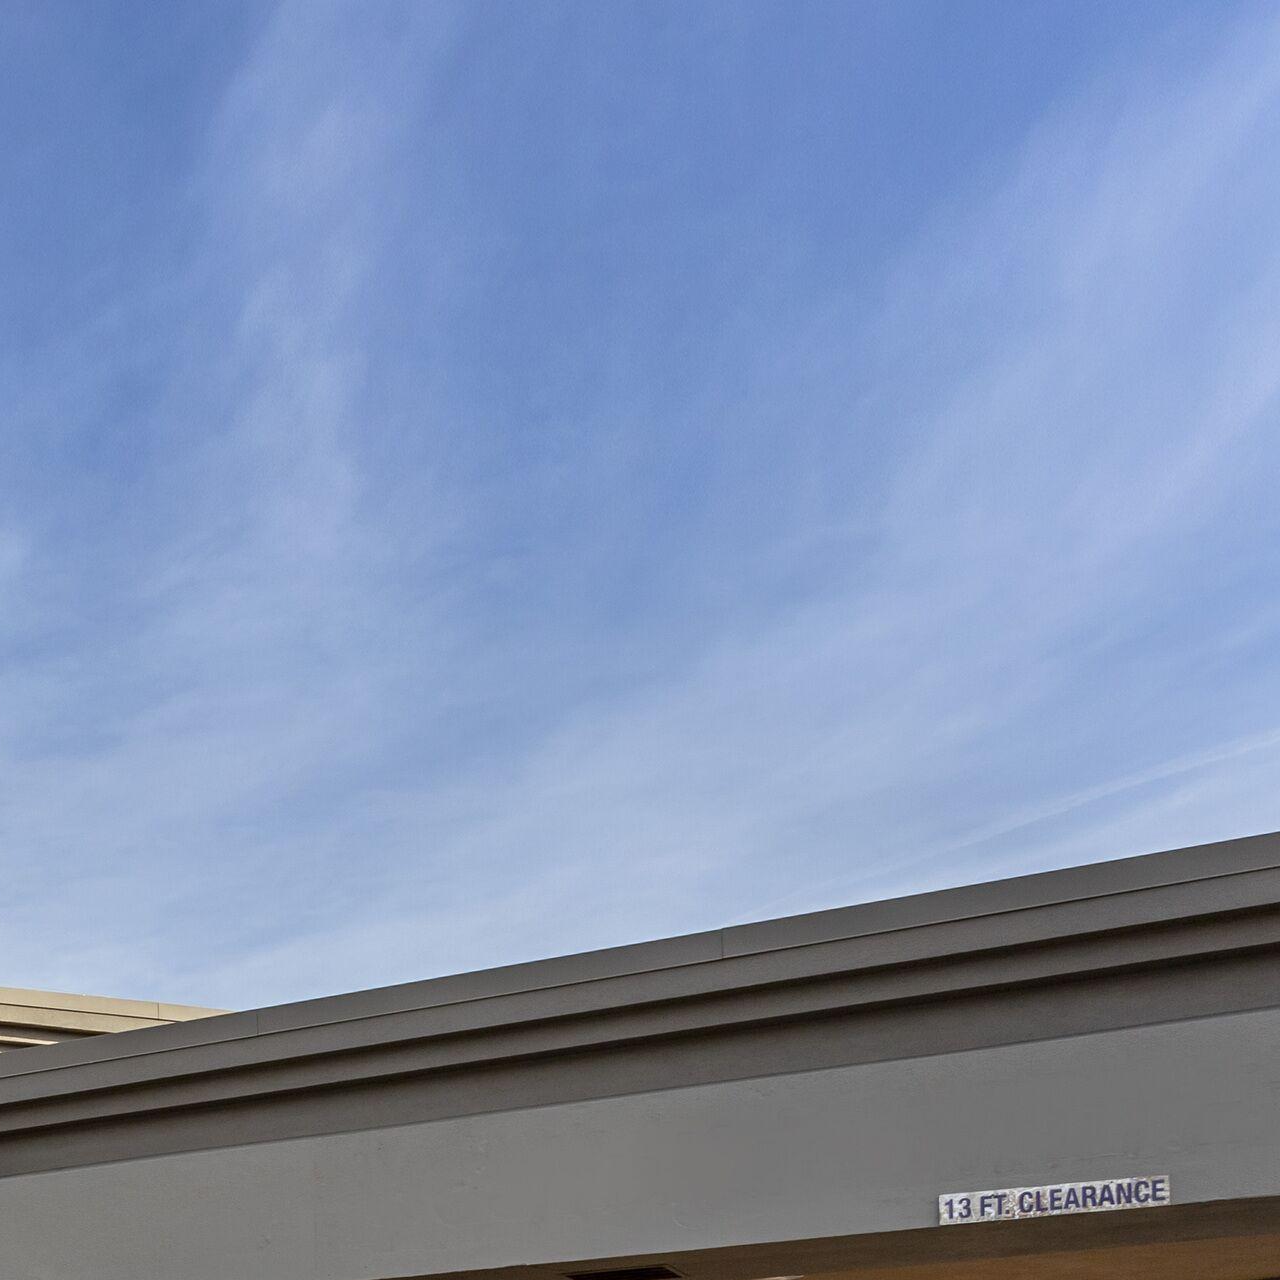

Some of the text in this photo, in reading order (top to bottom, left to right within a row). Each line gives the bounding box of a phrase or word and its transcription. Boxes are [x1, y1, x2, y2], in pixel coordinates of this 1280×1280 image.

[944, 1179, 1165, 1219] 13 FT. CLEARANCE
